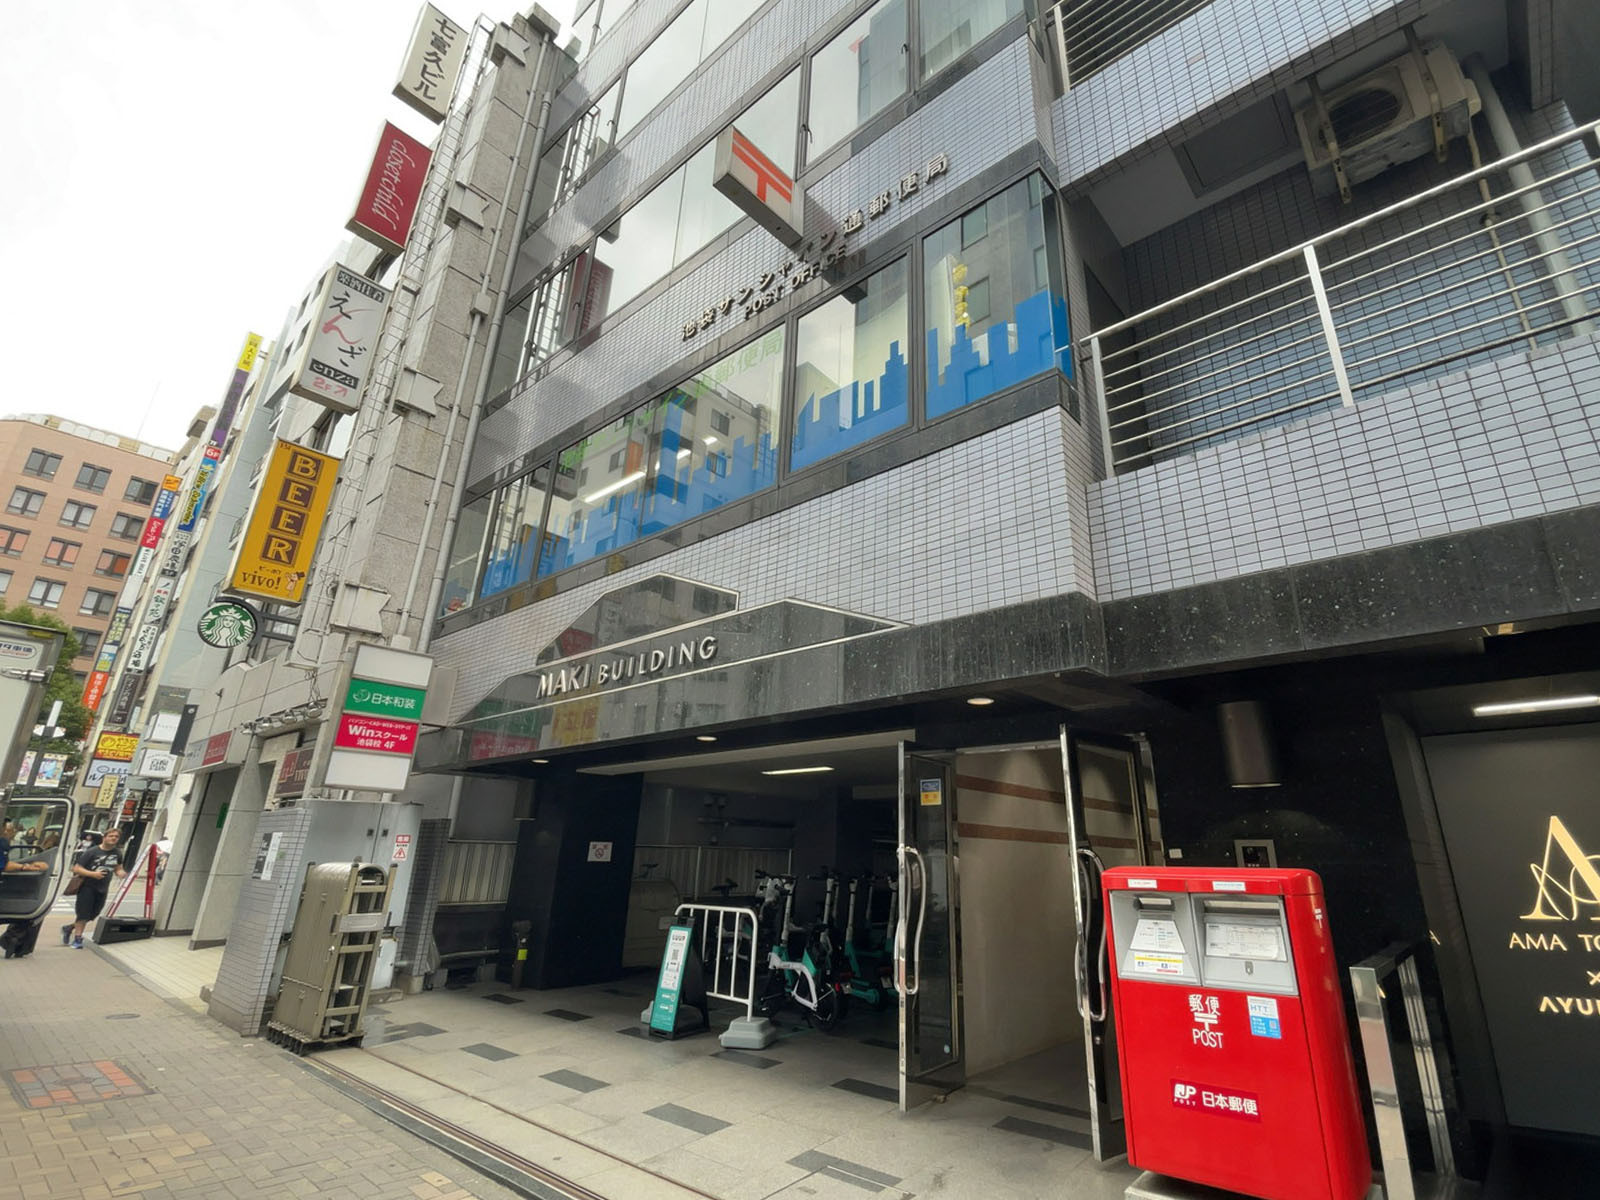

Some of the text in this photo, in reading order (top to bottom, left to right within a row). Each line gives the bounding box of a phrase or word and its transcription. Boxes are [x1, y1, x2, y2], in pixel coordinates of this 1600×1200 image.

[743, 246, 848, 320] POST OFFICE
[311, 362, 357, 387] enza
[206, 448, 220, 459] 6F
[268, 454, 317, 564] BEER
[242, 570, 281, 590] vivo!
[536, 636, 718, 700] MAKI BUILDING
[371, 692, 416, 709] 日本和装
[348, 724, 409, 741] Winスクール
[357, 738, 396, 749] 池袋校 4F
[1509, 932, 1568, 952] AMA
[1188, 994, 1221, 1015] 郵便
[1250, 1004, 1268, 1013] HTT
[1192, 1028, 1224, 1048] POST
[1174, 1083, 1258, 1115] JP 日本郵便
